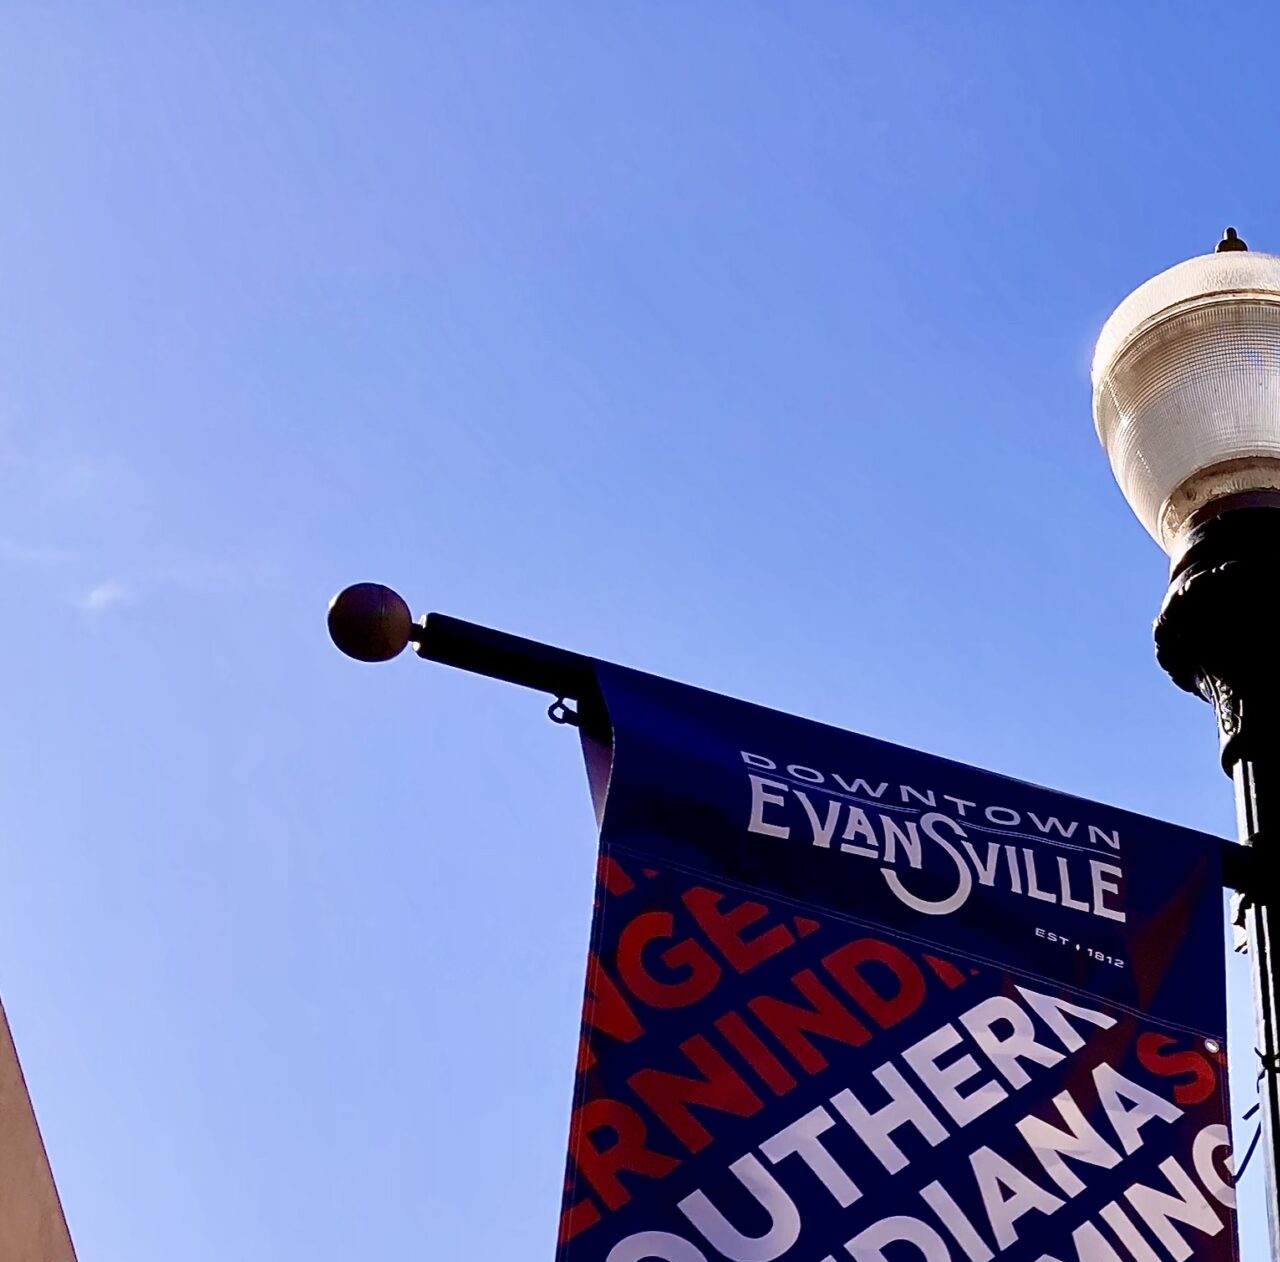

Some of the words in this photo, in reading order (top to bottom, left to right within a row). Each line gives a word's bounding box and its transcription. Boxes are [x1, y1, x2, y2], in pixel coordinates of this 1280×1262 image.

[741, 751, 1121, 850] DOWNTOWN
[748, 775, 1126, 923] EVANSVILLE
[1035, 927, 1070, 945] EST
[1087, 948, 1125, 969] 1812
